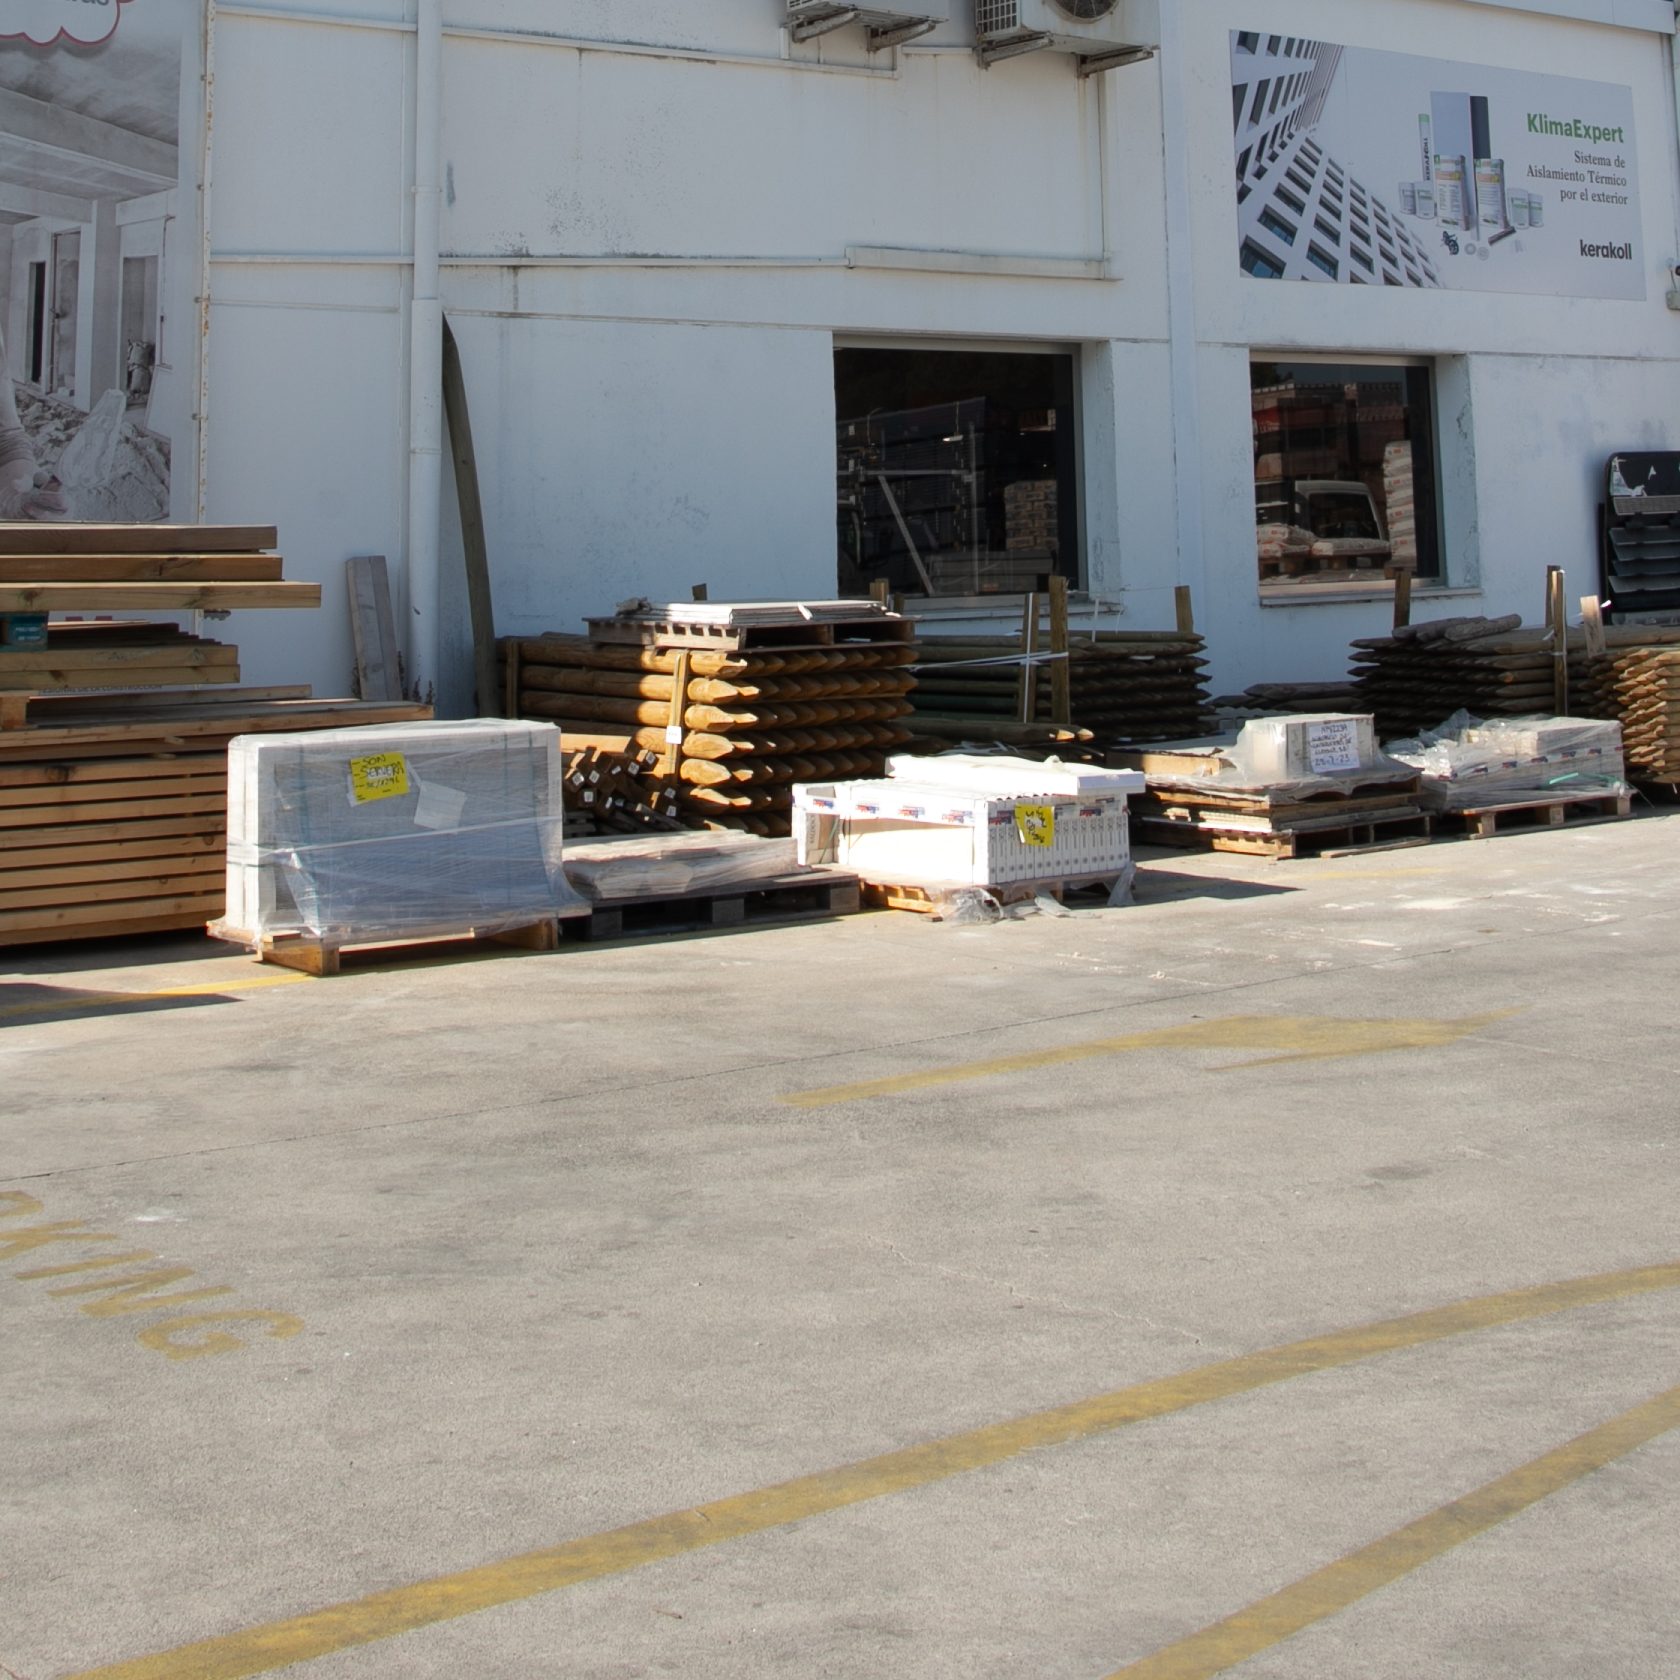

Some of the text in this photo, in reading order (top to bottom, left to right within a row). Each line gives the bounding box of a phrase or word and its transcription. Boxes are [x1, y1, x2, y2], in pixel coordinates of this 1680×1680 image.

[1526, 112, 1624, 144] KlimaExpert
[1574, 150, 1626, 168] Sistema de
[1526, 164, 1627, 187] Aislamiento Térmico
[1560, 188, 1628, 205] por el exterior
[1580, 239, 1633, 260] kerakoll
